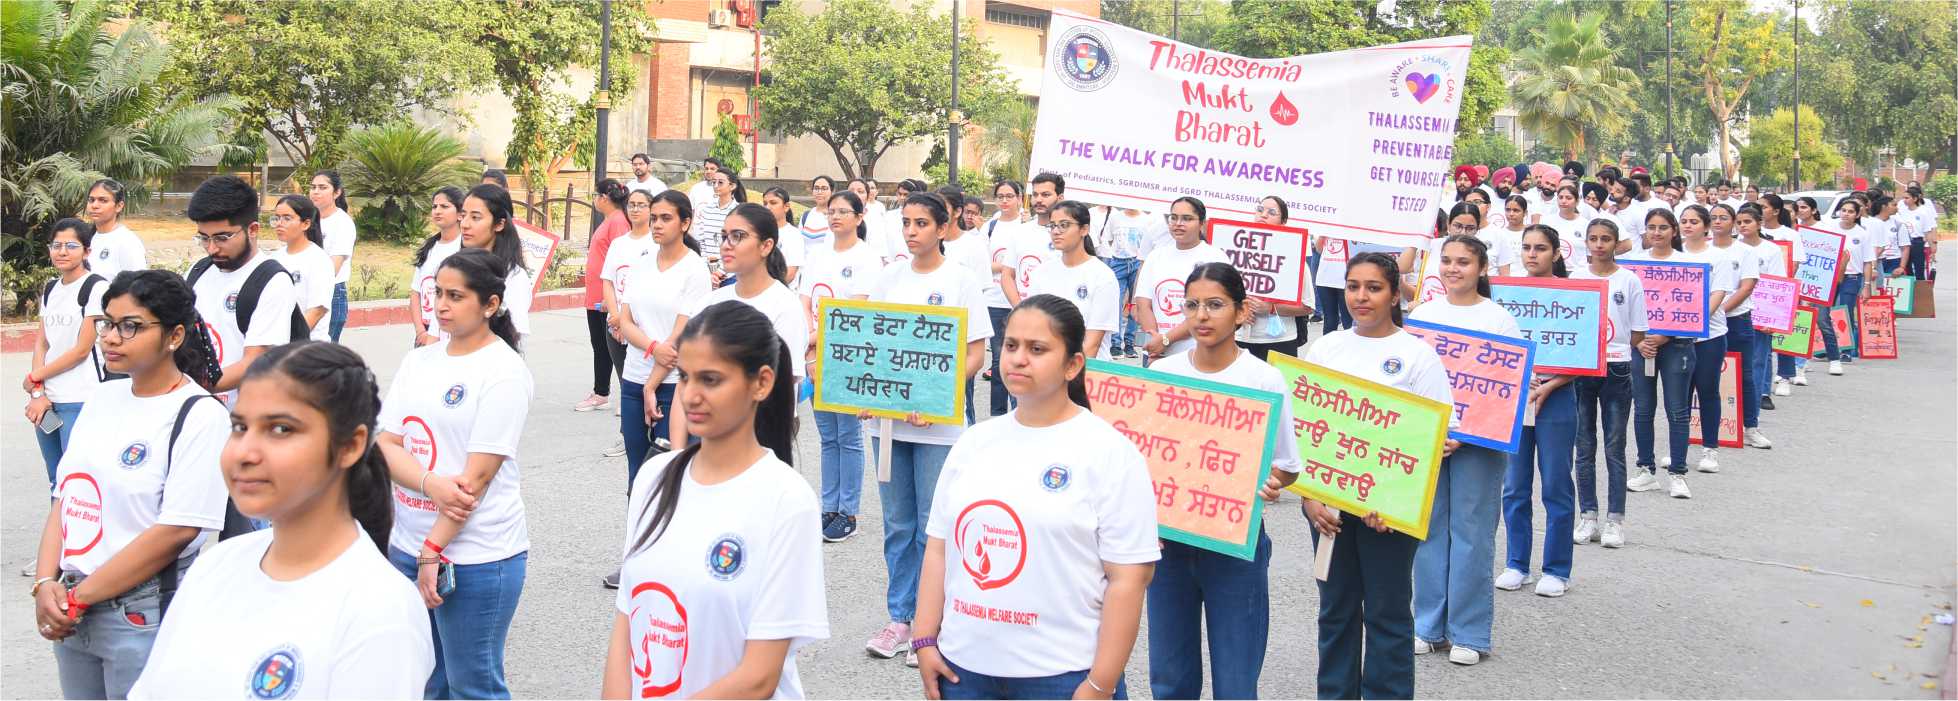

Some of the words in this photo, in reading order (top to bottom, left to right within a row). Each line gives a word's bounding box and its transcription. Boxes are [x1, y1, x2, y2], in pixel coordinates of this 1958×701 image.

[1149, 40, 1302, 83] Thalassemia
[1181, 80, 1253, 113] Mukt
[1174, 110, 1266, 149] Bharat
[1059, 139, 1096, 159] THE
[1101, 144, 1157, 168] WALK
[1161, 152, 1200, 174] FOR
[1203, 157, 1325, 189] AWARENESS
[1370, 166, 1393, 181] GET
[1063, 171, 1072, 179] of
[1074, 172, 1116, 186] Pediatrics,
[1118, 178, 1161, 191] SGRDIMSR
[1162, 184, 1178, 193] and
[1180, 186, 1202, 197] SGRD
[1204, 190, 1262, 204] THALASSEMIA
[1303, 201, 1337, 215] SOCIETY
[1391, 195, 1428, 213] TESTED
[1233, 229, 1273, 251] GET
[1240, 270, 1276, 294] STED
[1801, 283, 1823, 298] URE
[1496, 298, 1585, 321] ੈਲੇਸੀਮੀਆ
[829, 308, 865, 333] ਇਕ
[912, 314, 954, 342] ਟੈਸਟ
[1540, 330, 1578, 346] ਭਾਰਤ
[1476, 341, 1524, 370] ਟੈਸਟ
[845, 372, 913, 401] ਪਰਿਵਾਰ
[1199, 439, 1241, 475] ਫਿਰ
[1335, 432, 1371, 461] ਖੂਨ
[1377, 446, 1420, 475] ਜਾਂਚ
[66, 507, 81, 518] Mukt
[1187, 483, 1248, 524] ਸੰਤਾਨ
[982, 523, 1019, 537] Thalassemia
[983, 535, 997, 545] Mukt
[999, 538, 1018, 550] Bharat
